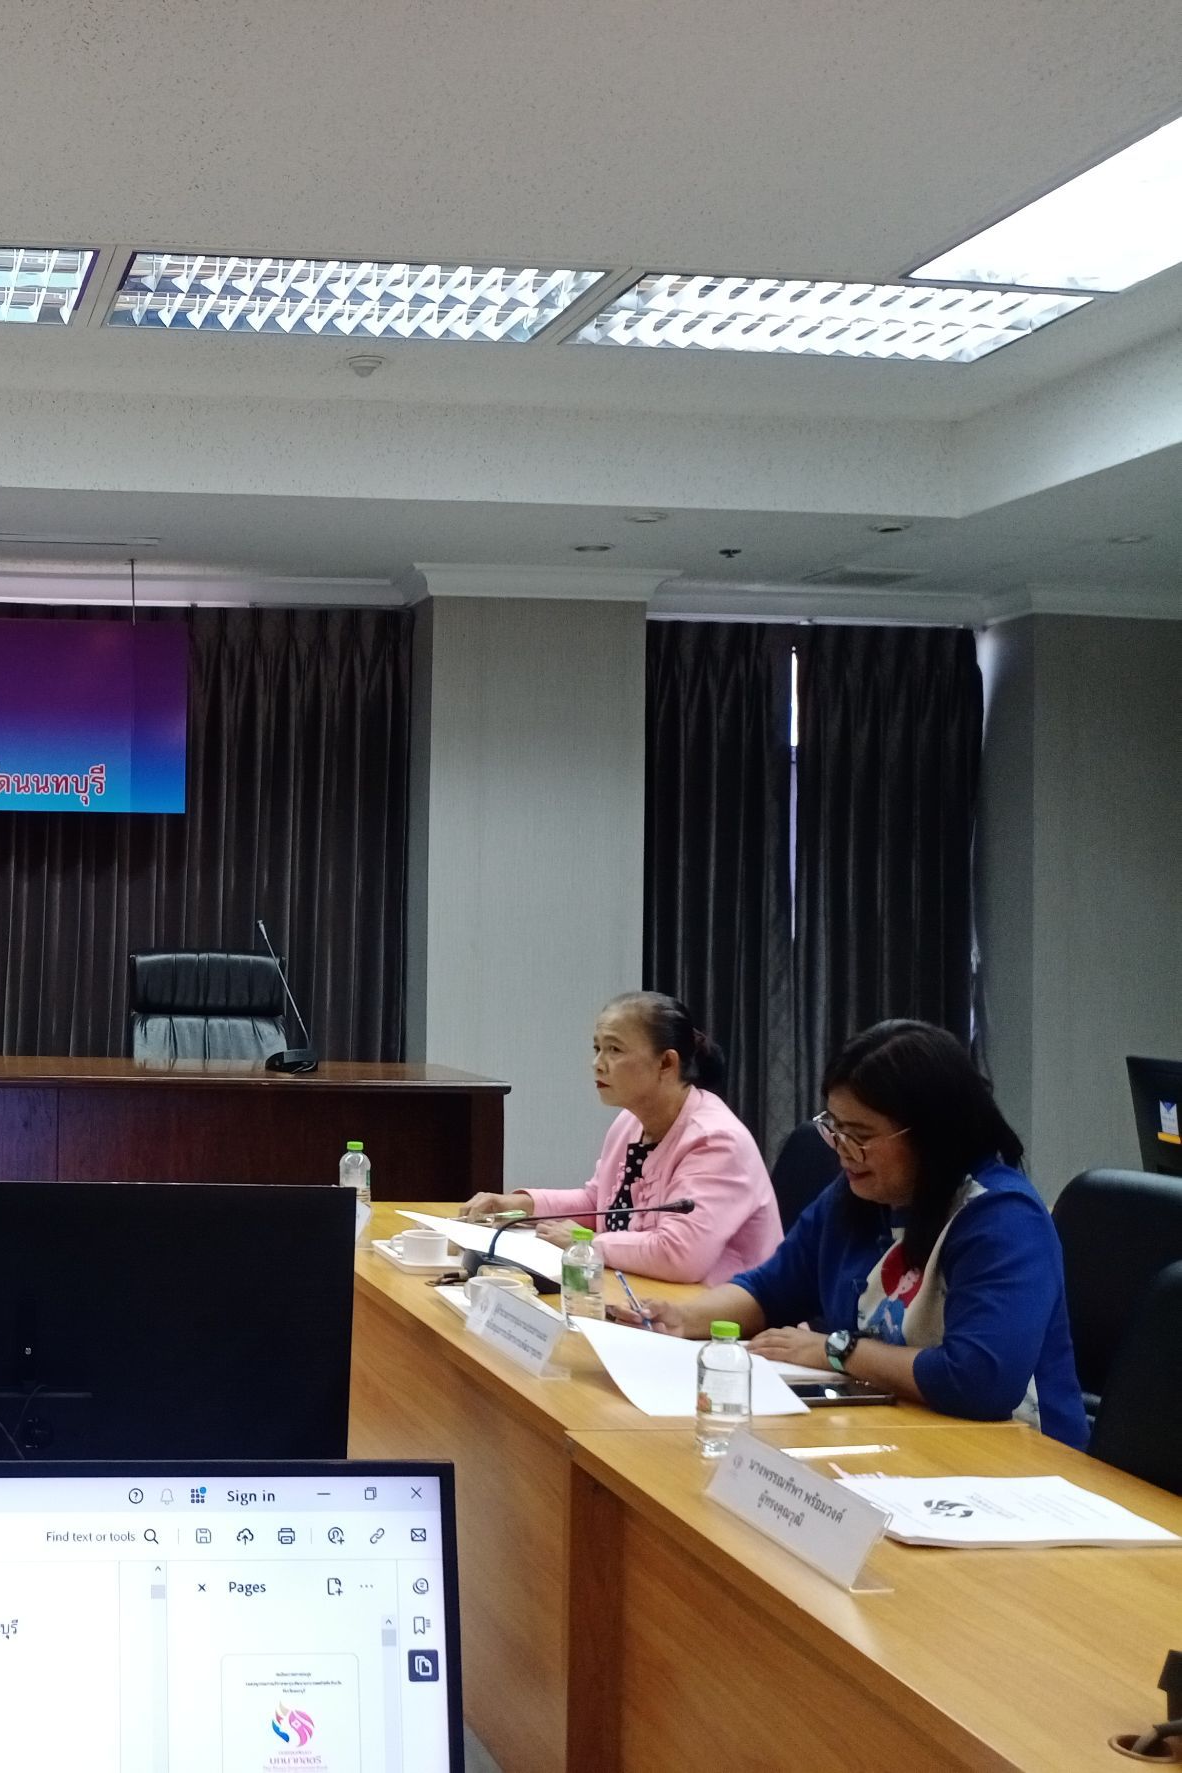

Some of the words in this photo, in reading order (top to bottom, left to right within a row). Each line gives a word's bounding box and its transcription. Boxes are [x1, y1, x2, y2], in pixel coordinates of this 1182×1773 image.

[227, 1490, 258, 1505] Sign
[262, 1490, 276, 1502] in
[46, 1531, 69, 1542] Find
[72, 1531, 93, 1542] text
[95, 1534, 106, 1542] or
[109, 1531, 136, 1542] tools
[228, 1582, 267, 1597] Pages
